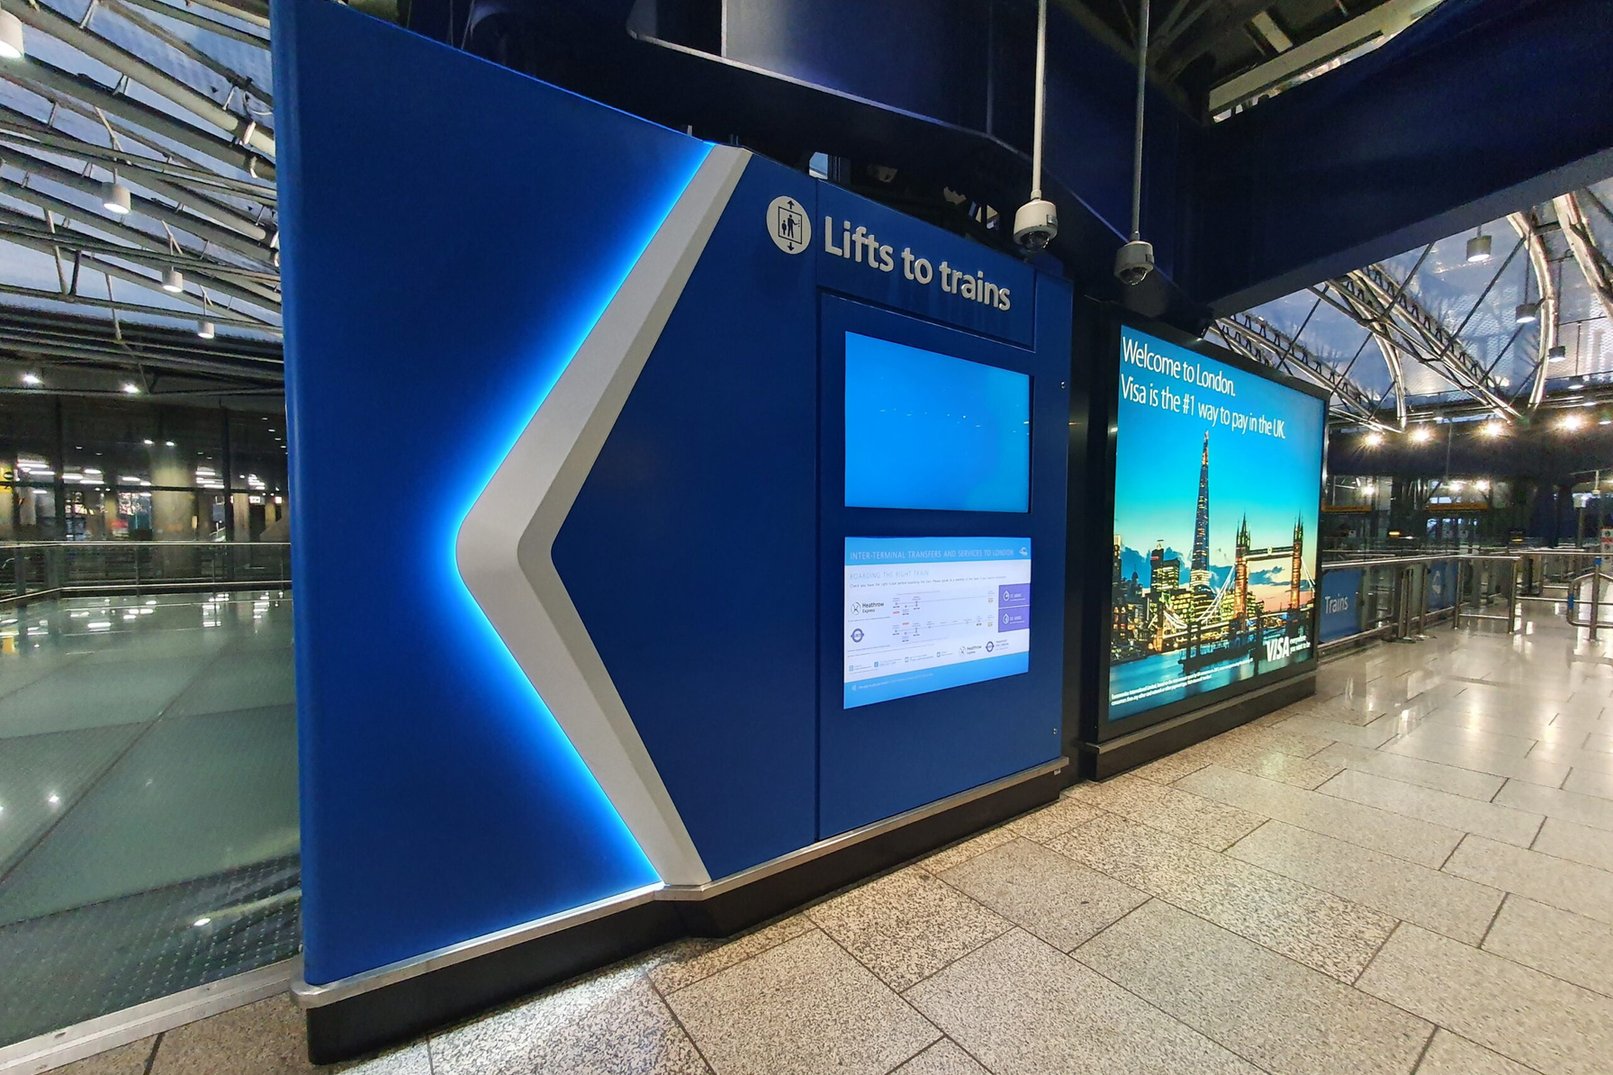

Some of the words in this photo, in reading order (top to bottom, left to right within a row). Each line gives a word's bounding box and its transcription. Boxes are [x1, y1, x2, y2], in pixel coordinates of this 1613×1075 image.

[824, 215, 894, 272] Lifts
[901, 247, 933, 285] to
[938, 261, 1011, 311] trains
[1122, 336, 1181, 379] Welcome
[1183, 361, 1195, 382] to
[1196, 363, 1236, 397] London.
[1121, 373, 1146, 404] Visa
[1149, 383, 1158, 407] is
[1161, 386, 1181, 413] the
[1183, 393, 1195, 416] #1
[1198, 402, 1219, 427] way
[1220, 406, 1231, 425] to
[1232, 412, 1249, 435] pay
[1249, 412, 1258, 431] in
[1258, 415, 1273, 436] the
[850, 551, 905, 560] INTER-TERMINAL
[908, 550, 942, 559] TRANSFERS
[944, 549, 956, 558] AND
[1325, 593, 1348, 614] Trains
[1264, 636, 1290, 662] VISA
